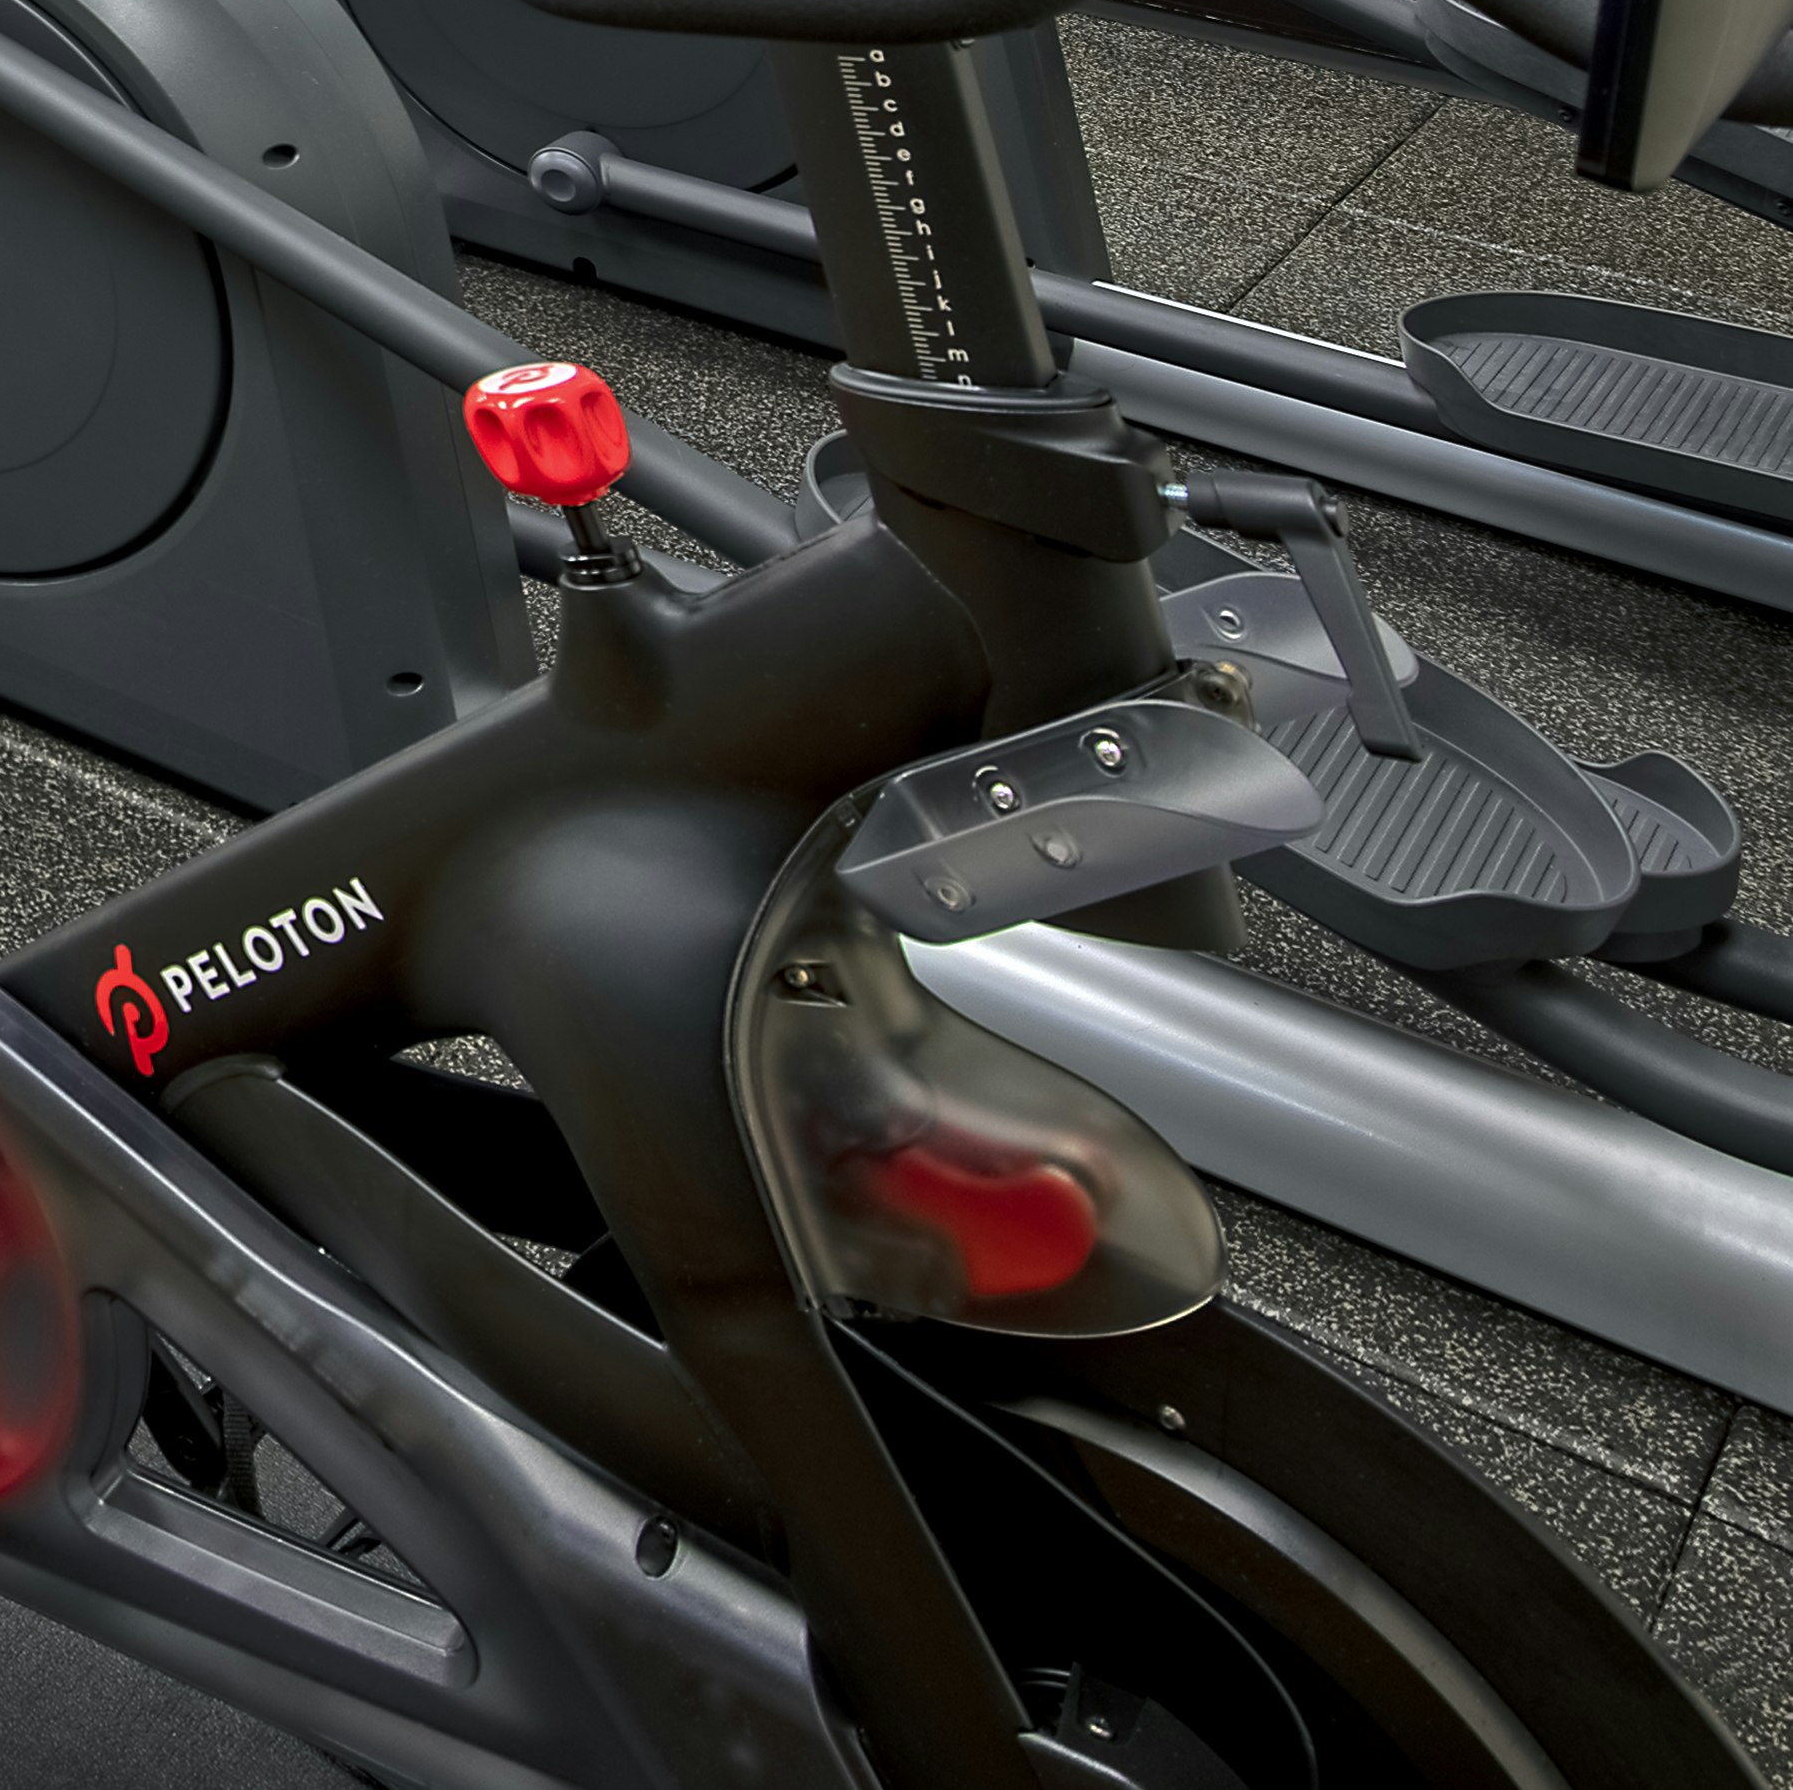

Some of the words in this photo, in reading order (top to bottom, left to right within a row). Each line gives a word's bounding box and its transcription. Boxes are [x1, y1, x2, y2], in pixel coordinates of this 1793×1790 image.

[869, 49, 885, 63] a
[875, 71, 892, 88] b
[883, 99, 898, 112] c
[889, 121, 905, 137] d
[896, 148, 911, 162] e
[905, 169, 914, 186] f
[909, 198, 926, 215] g
[915, 219, 932, 236] h
[933, 269, 942, 290] j
[937, 295, 952, 312] k
[947, 348, 969, 363] m
[160, 877, 384, 1013] PELOTON
